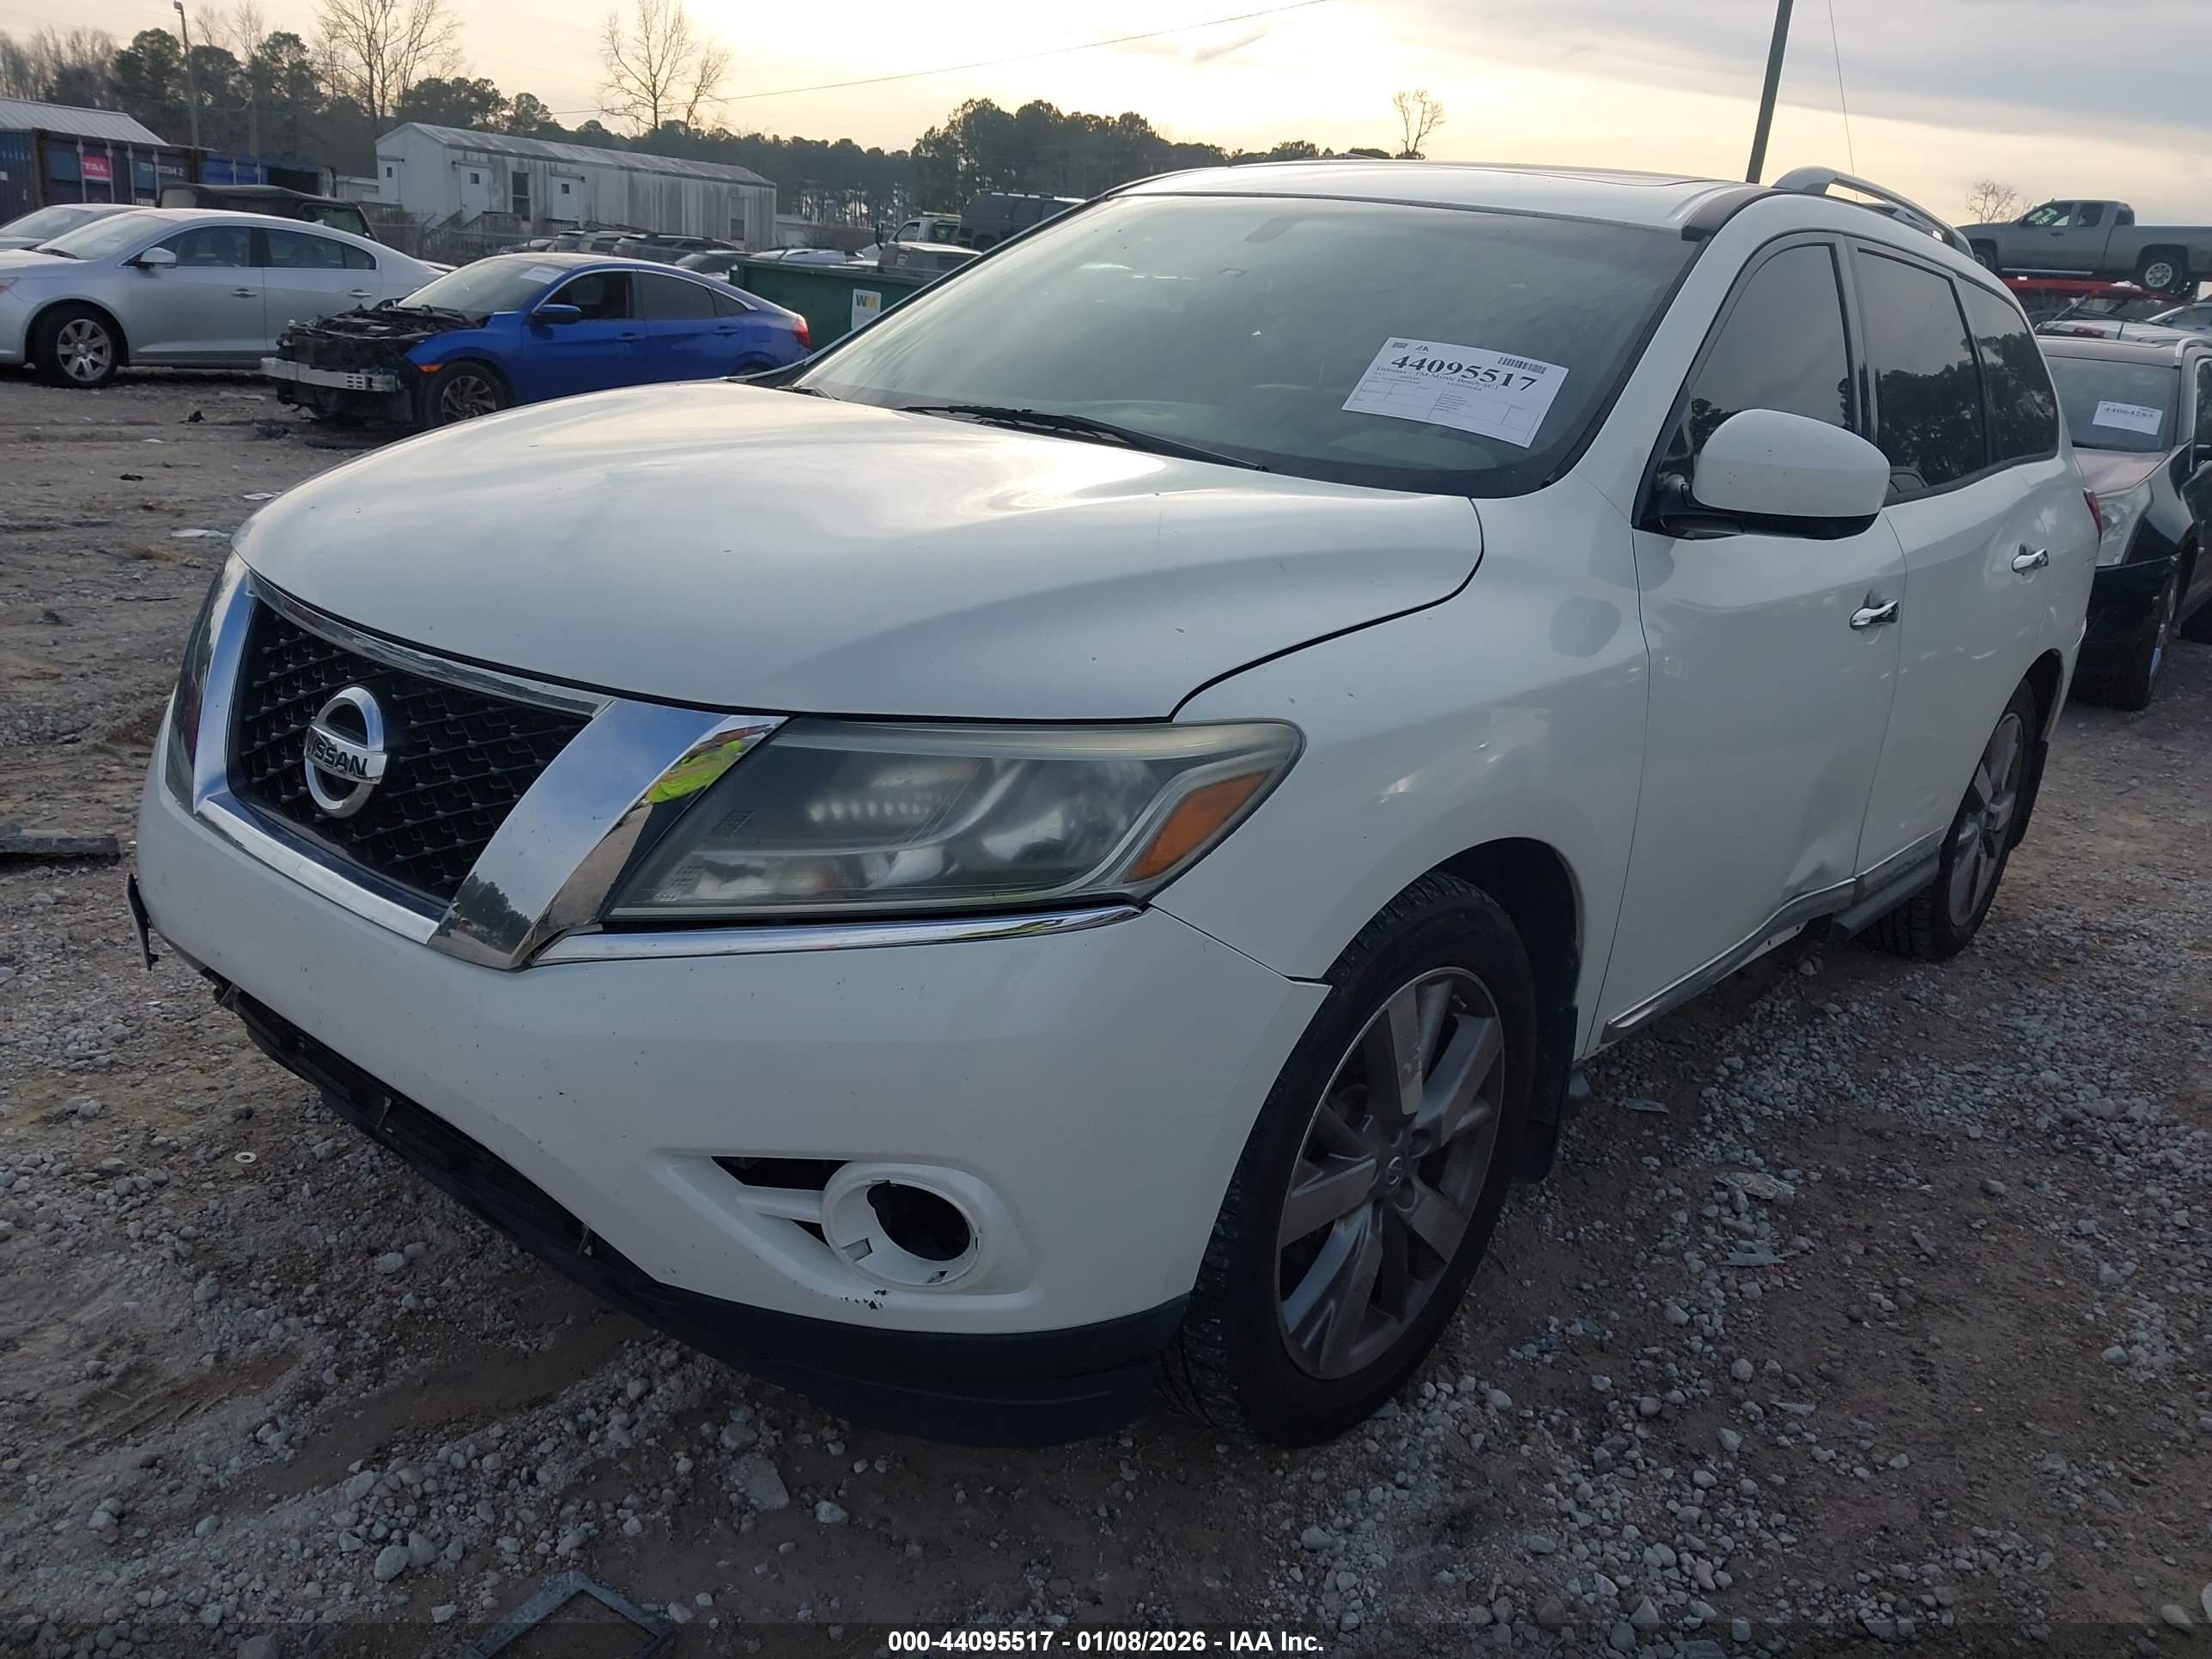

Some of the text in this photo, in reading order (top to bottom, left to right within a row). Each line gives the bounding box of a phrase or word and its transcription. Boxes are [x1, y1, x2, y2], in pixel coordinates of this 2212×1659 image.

[82, 161, 107, 172] TAL
[856, 294, 877, 309] WM
[1391, 355, 1537, 392] 44095517
[306, 727, 368, 776] NISSAN
